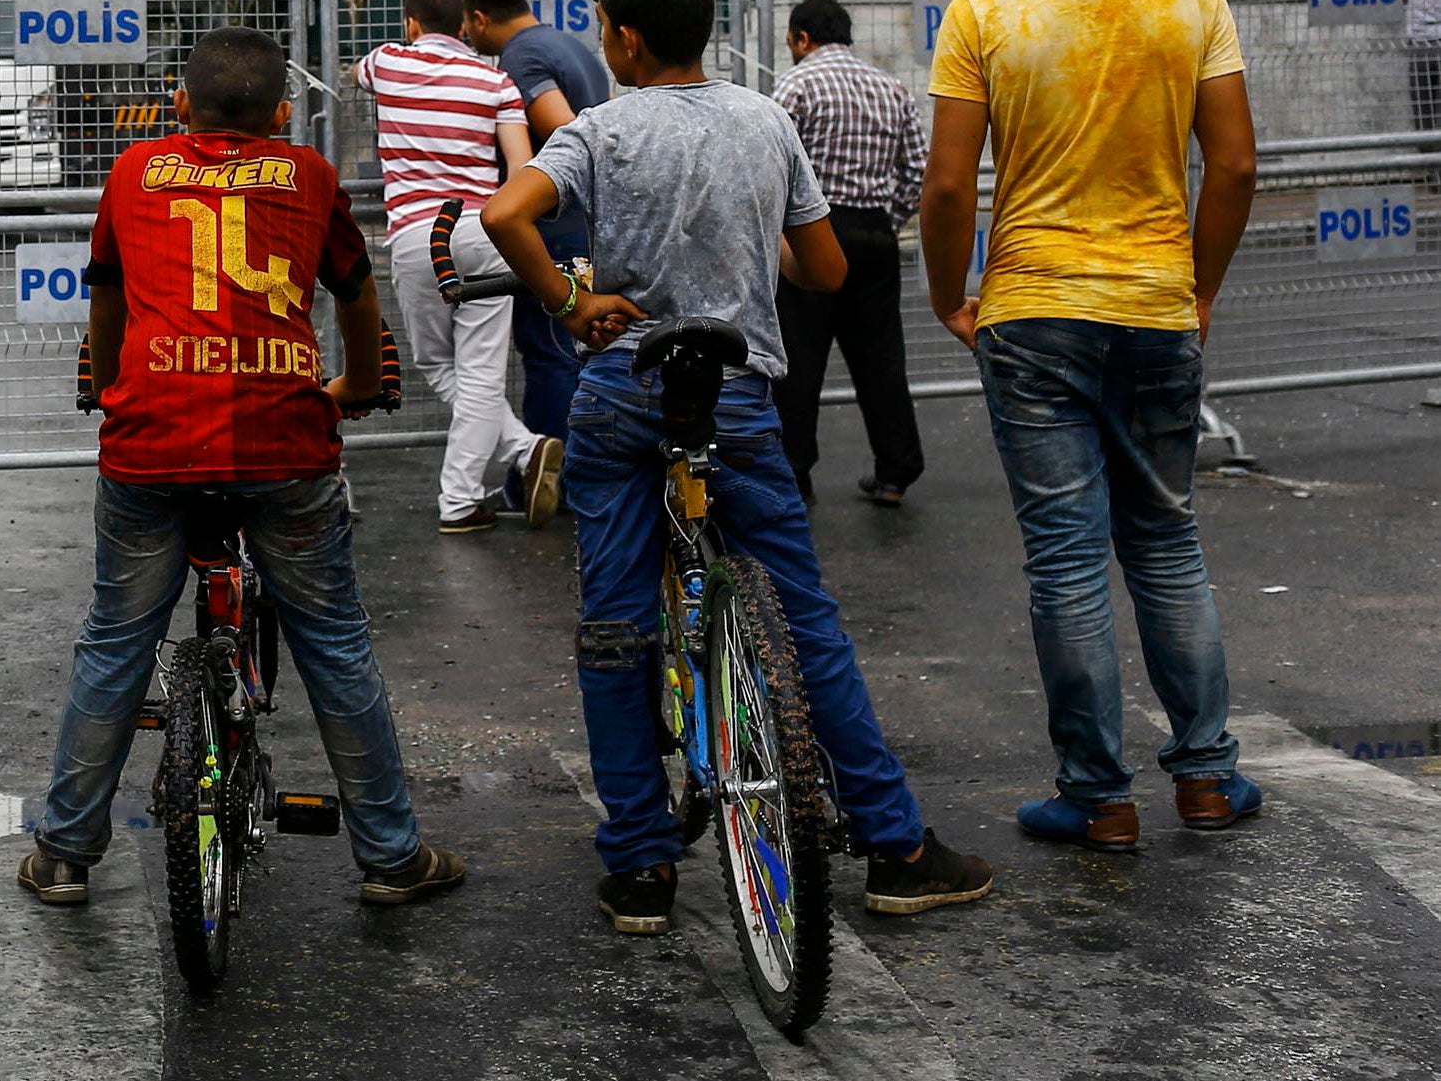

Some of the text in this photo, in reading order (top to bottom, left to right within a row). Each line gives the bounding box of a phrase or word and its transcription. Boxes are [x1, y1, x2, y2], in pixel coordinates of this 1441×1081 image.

[19, 1, 140, 45] POLİS
[142, 153, 297, 192] ÜLKER
[1320, 198, 1411, 243] POLİS
[170, 195, 304, 319] 14
